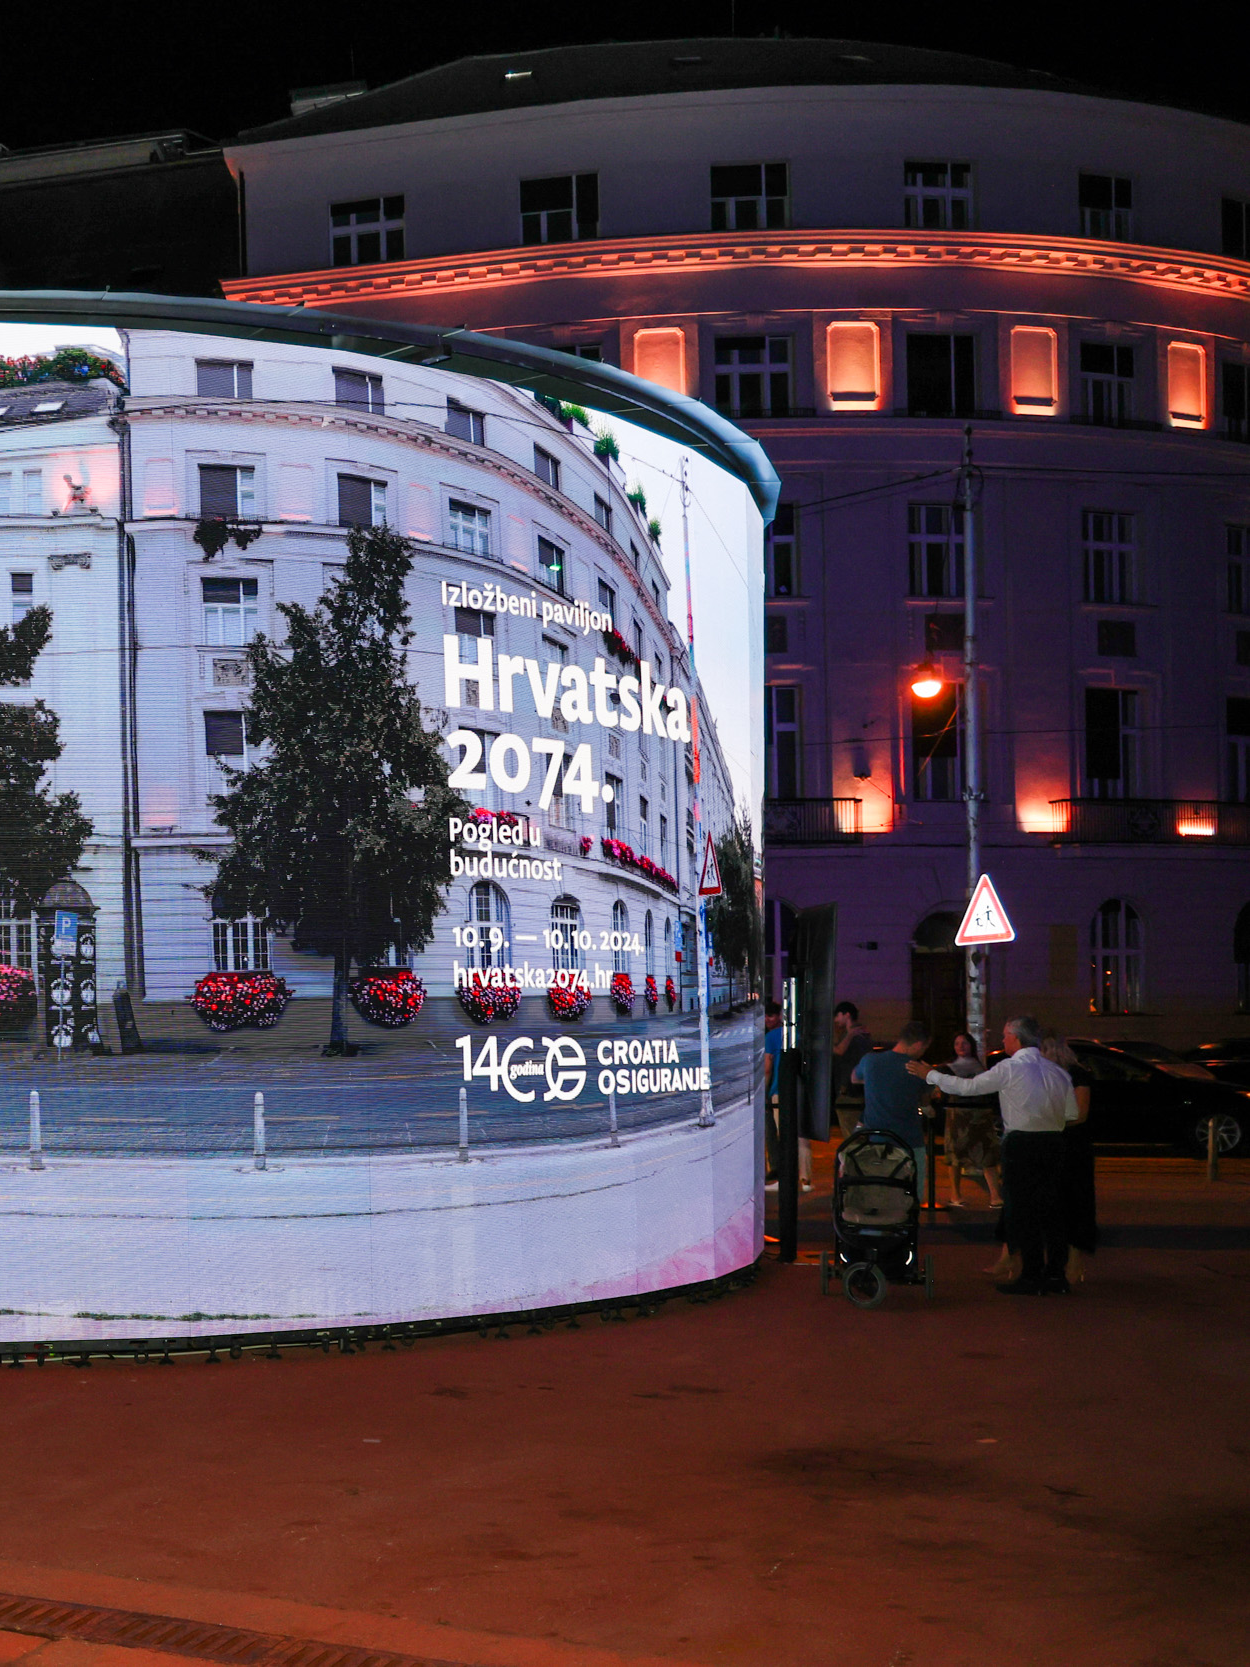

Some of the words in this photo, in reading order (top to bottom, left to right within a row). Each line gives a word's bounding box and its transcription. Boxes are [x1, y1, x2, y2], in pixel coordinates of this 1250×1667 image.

[441, 580, 538, 619] Izložbeni
[542, 599, 613, 636] paviljon
[443, 633, 692, 744] Hrvatska
[446, 729, 615, 815] 2074.
[449, 817, 524, 850] Pogled
[527, 826, 541, 848] u
[450, 848, 563, 882] budućnost
[599, 930, 645, 957] 2024.
[453, 960, 614, 993] hrvatska2074.hr
[597, 1039, 680, 1065] CROATIA
[510, 1060, 545, 1080] godina
[597, 1066, 712, 1095] OSIGURANJE
